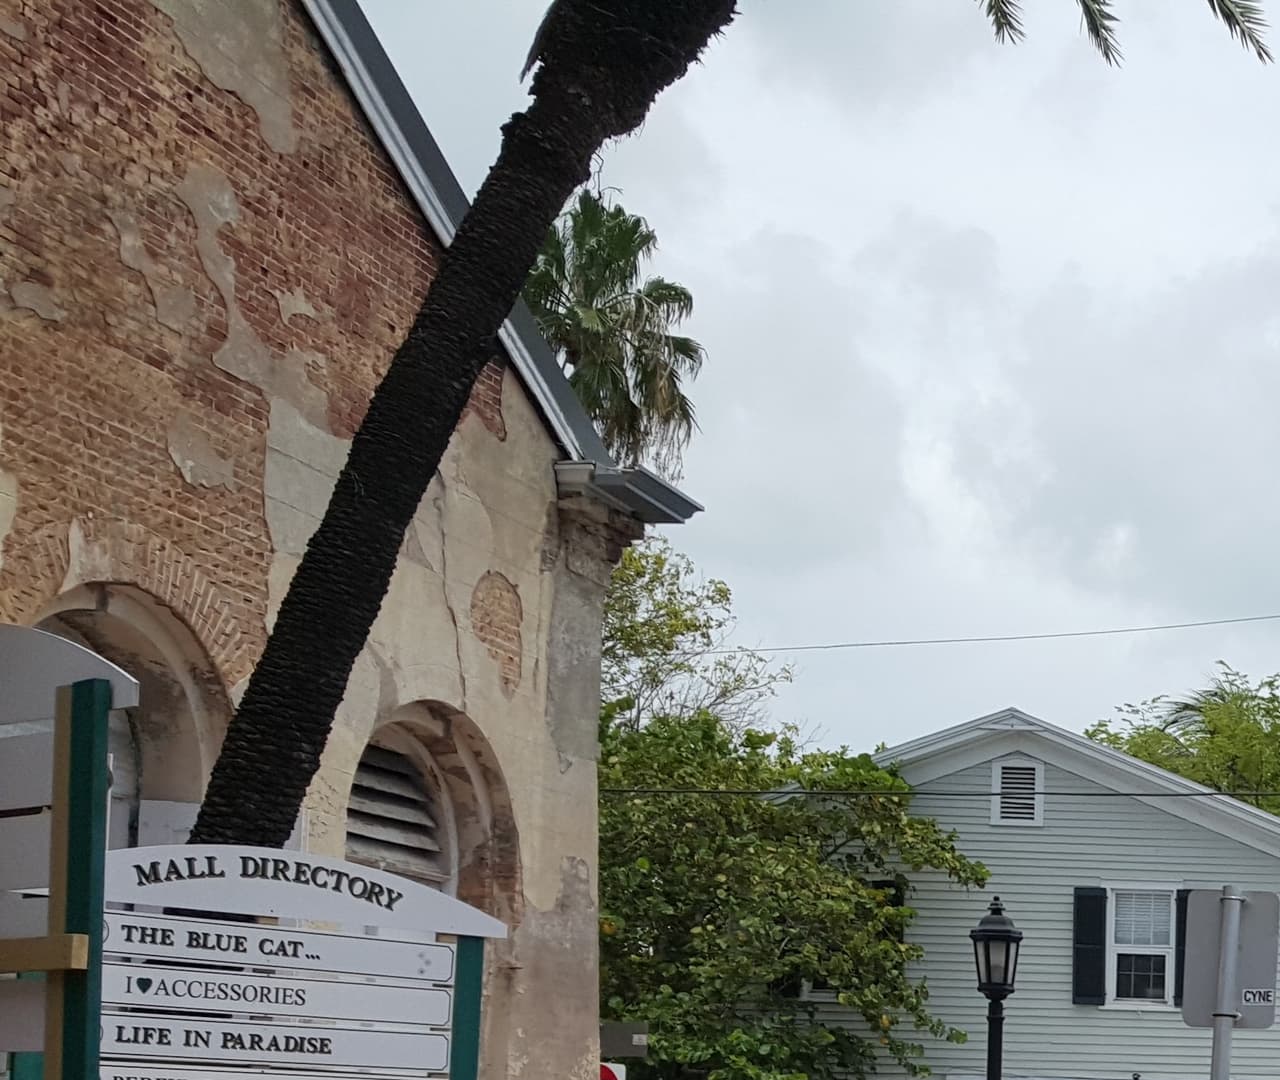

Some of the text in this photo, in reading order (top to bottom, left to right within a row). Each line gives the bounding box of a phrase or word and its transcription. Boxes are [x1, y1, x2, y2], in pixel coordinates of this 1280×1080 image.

[133, 856, 404, 911] MALL DIRECTORY
[121, 924, 320, 960] THE BLUE CAT...
[124, 976, 306, 1006] I ACCESSORIES
[1244, 990, 1273, 1002] CYNE
[115, 1026, 333, 1055] LIFE IN PARADISE
